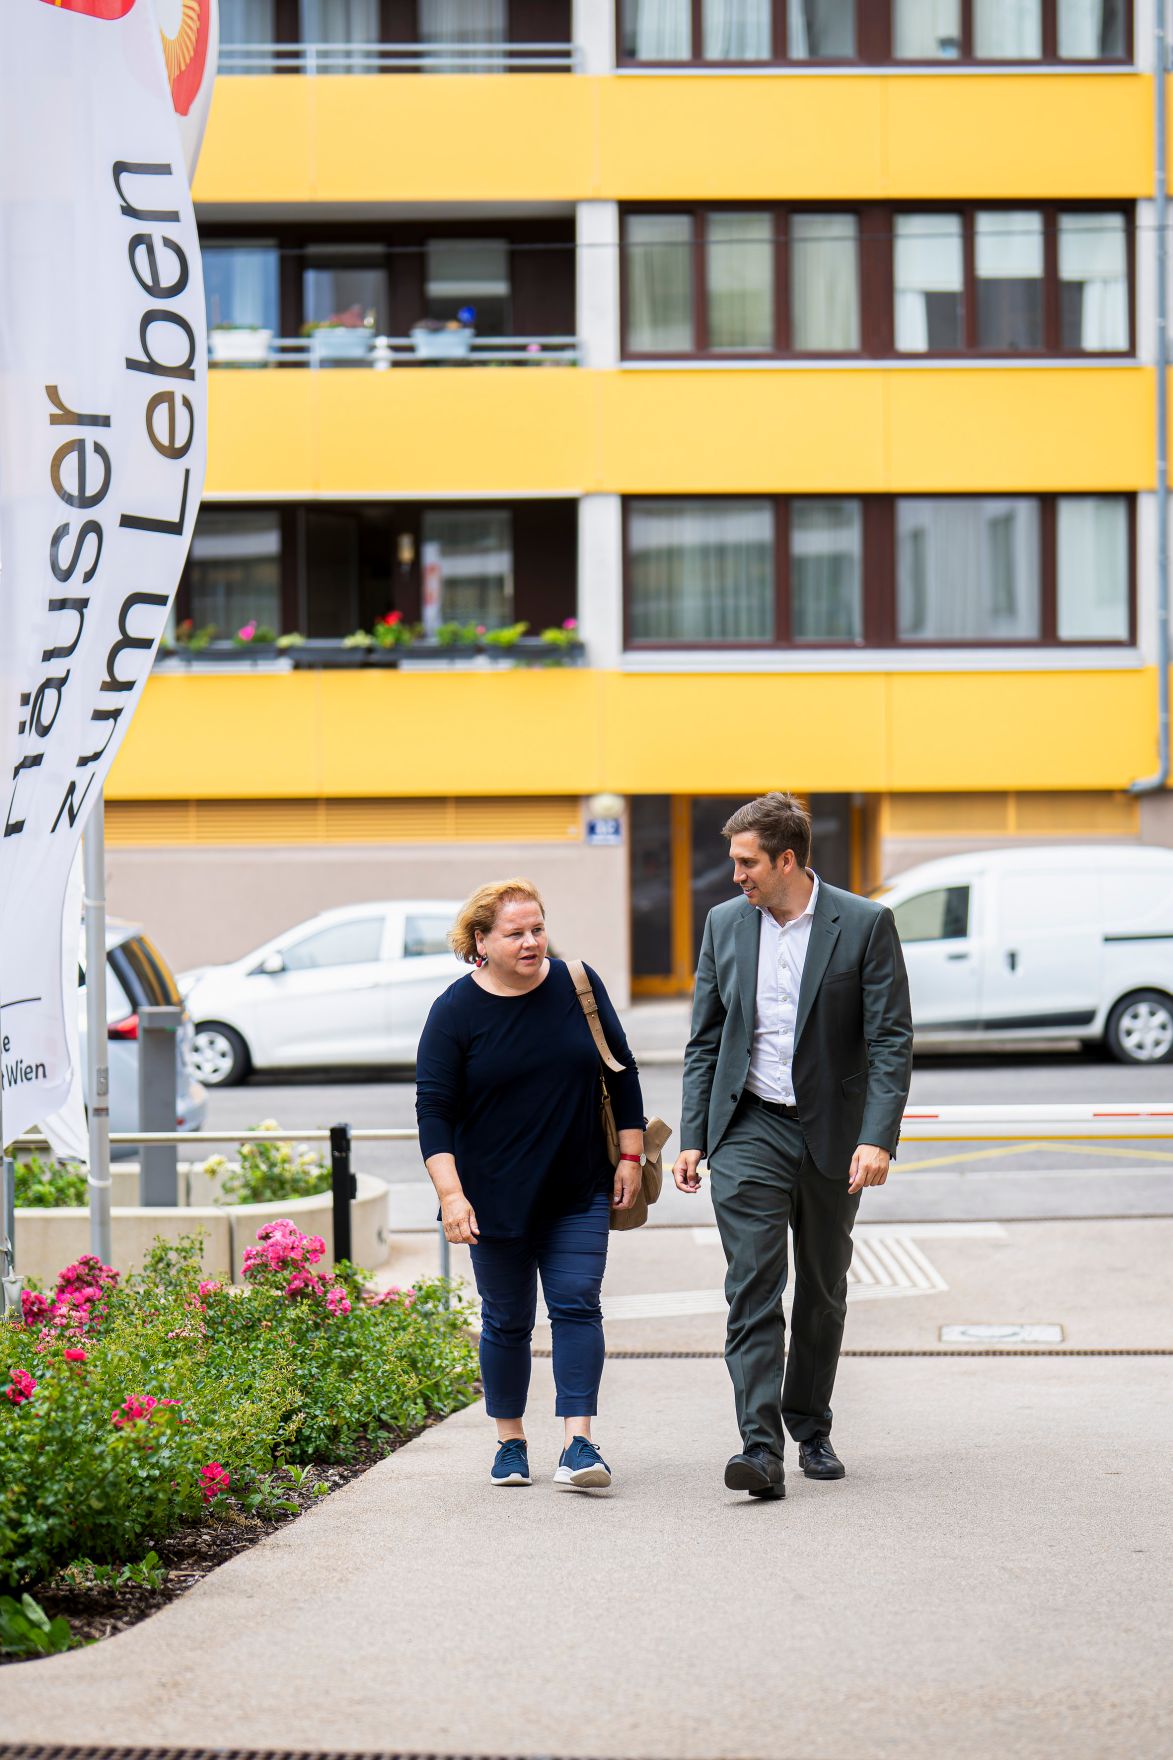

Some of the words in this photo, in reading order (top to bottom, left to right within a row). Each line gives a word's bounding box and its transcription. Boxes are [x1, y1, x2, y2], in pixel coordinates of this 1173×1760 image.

[50, 592, 170, 834] zum
[113, 160, 196, 536] Leben
[6, 1059, 47, 1087] Wien
